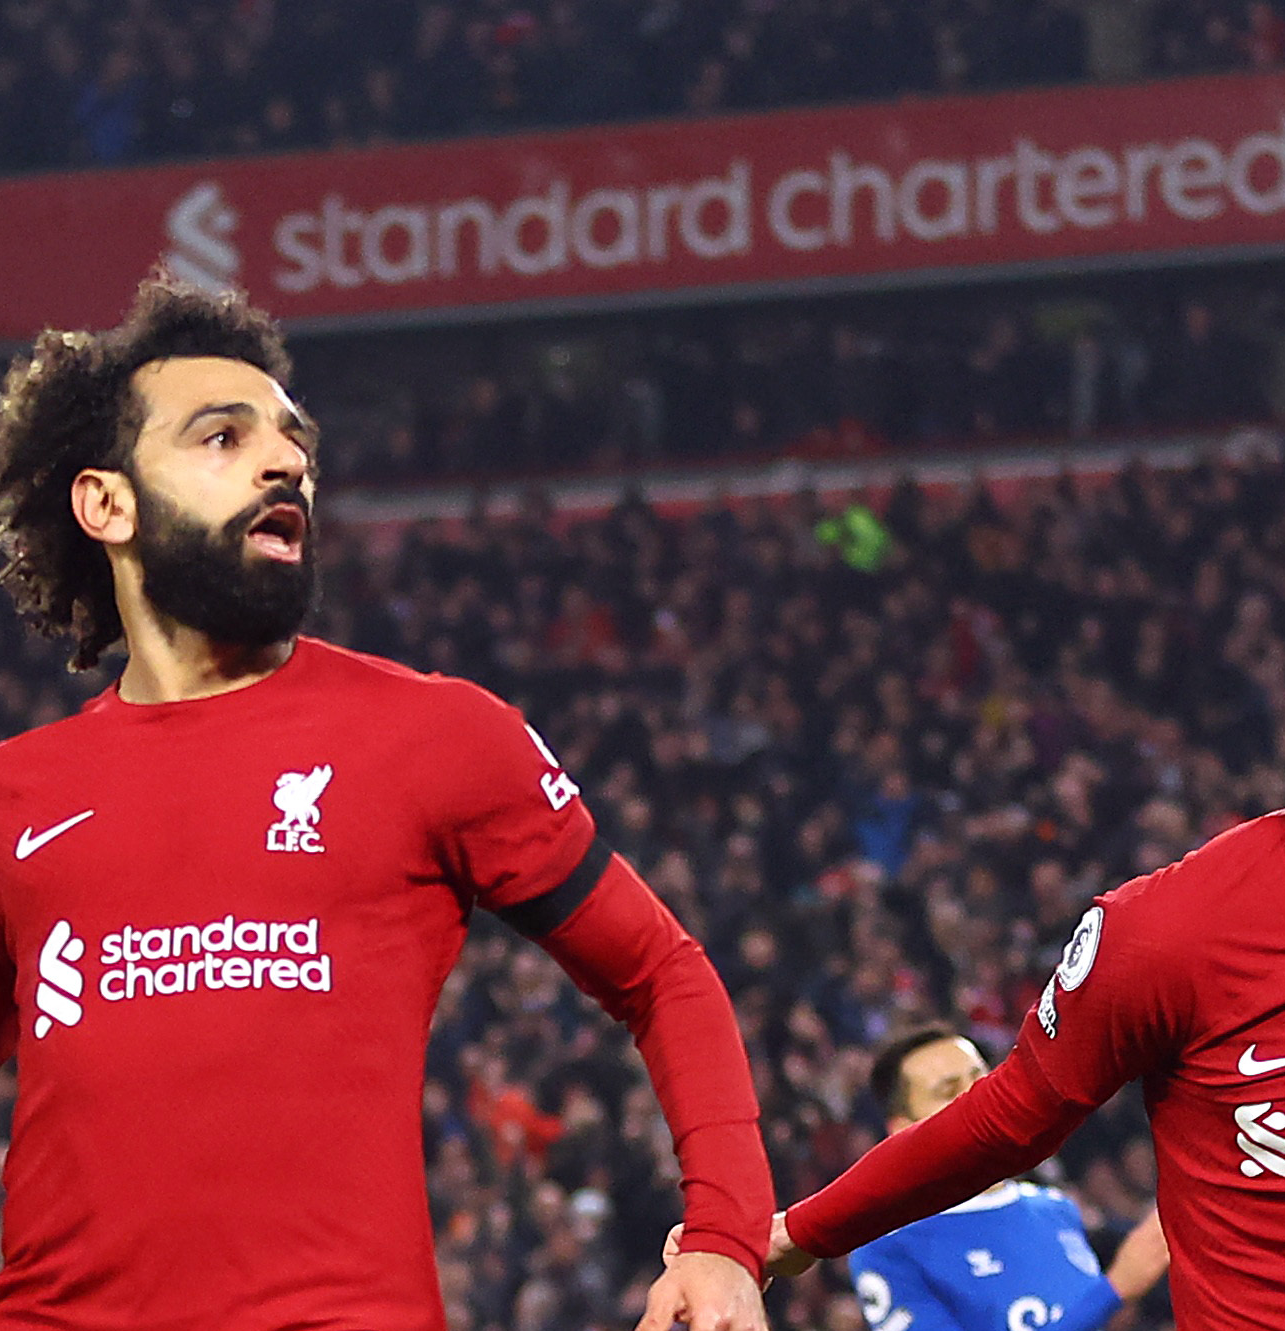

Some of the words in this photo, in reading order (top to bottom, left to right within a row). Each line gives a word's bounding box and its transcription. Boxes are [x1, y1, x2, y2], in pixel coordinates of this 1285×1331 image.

[274, 160, 751, 293] standard
[100, 916, 317, 965] standard
[99, 955, 331, 1001] chartered
